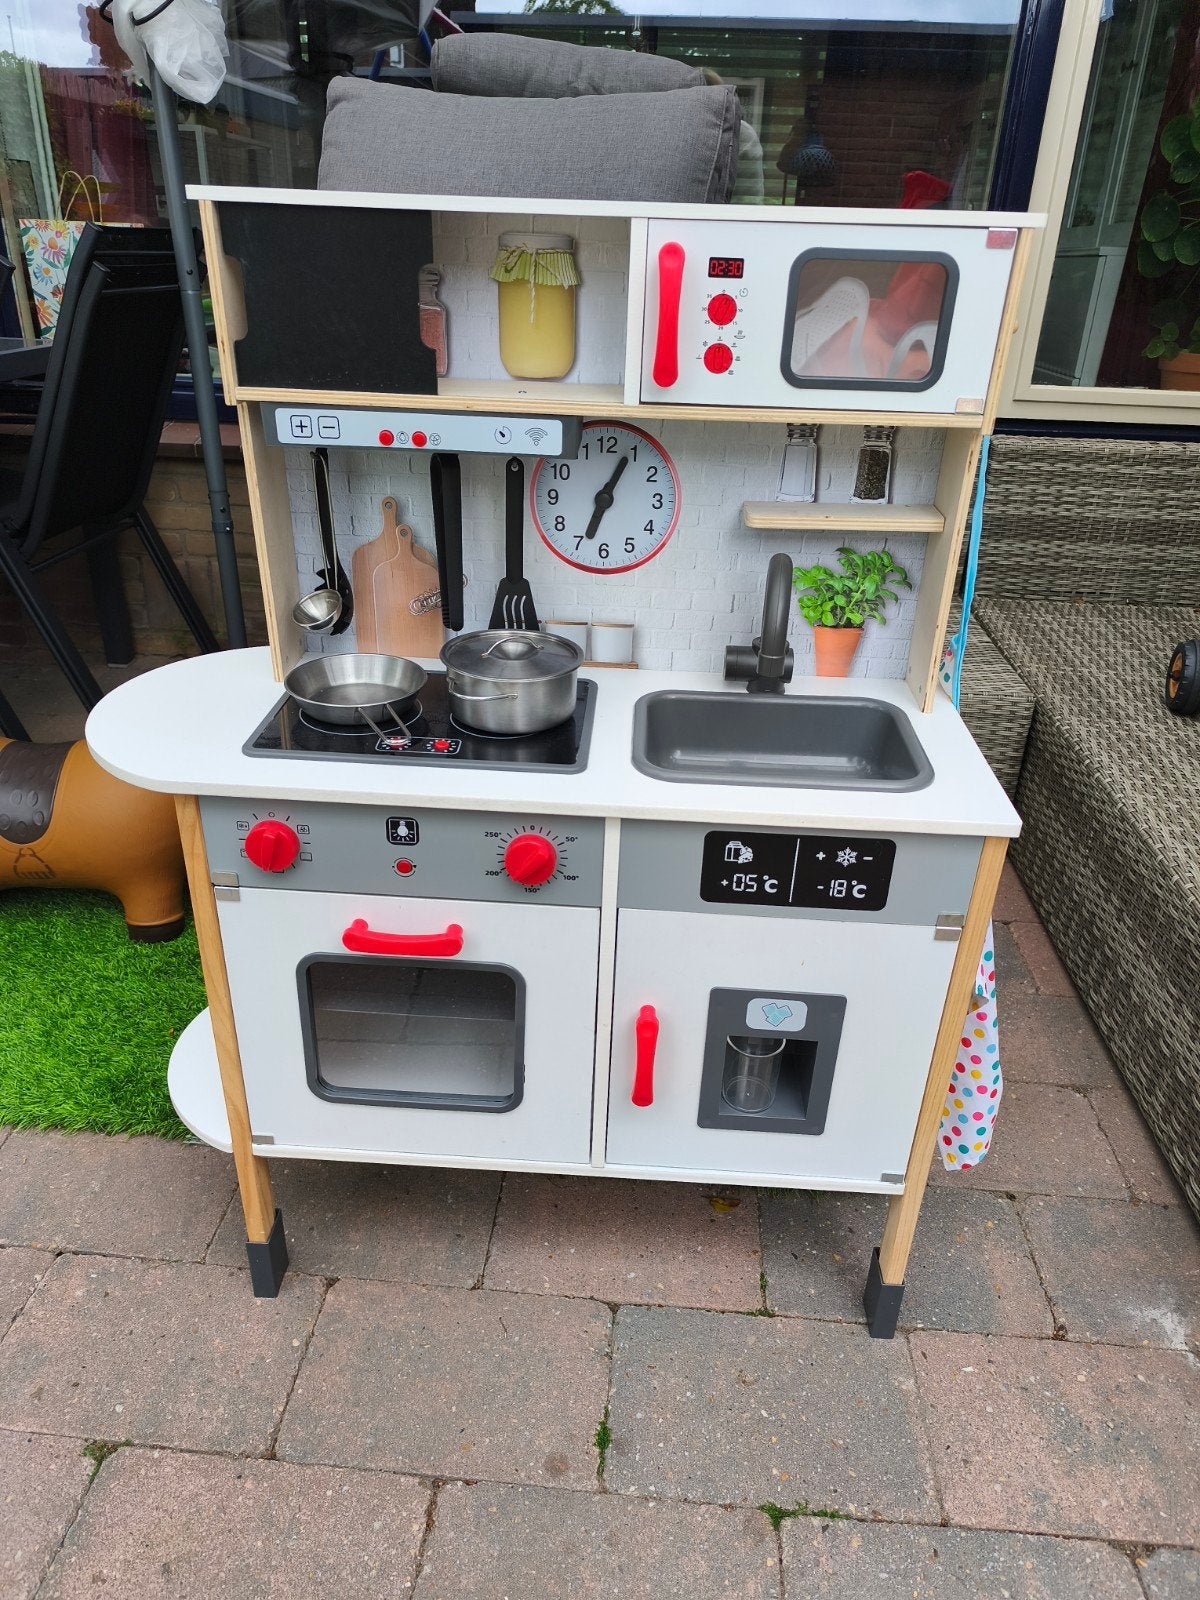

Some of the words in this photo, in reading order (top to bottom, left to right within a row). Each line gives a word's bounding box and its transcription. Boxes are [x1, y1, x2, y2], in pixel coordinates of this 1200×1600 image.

[710, 260, 743, 276] 02:30
[582, 443, 589, 460] 1
[597, 436, 618, 453] 12
[630, 445, 637, 462] 1
[551, 463, 570, 480] 10
[646, 466, 658, 482] 2
[547, 489, 559, 505] 9
[652, 493, 663, 509] 3
[554, 515, 565, 531] 8
[643, 520, 654, 535] 4
[573, 535, 584, 550] 7
[624, 538, 635, 553] 5
[598, 543, 609, 559] 6
